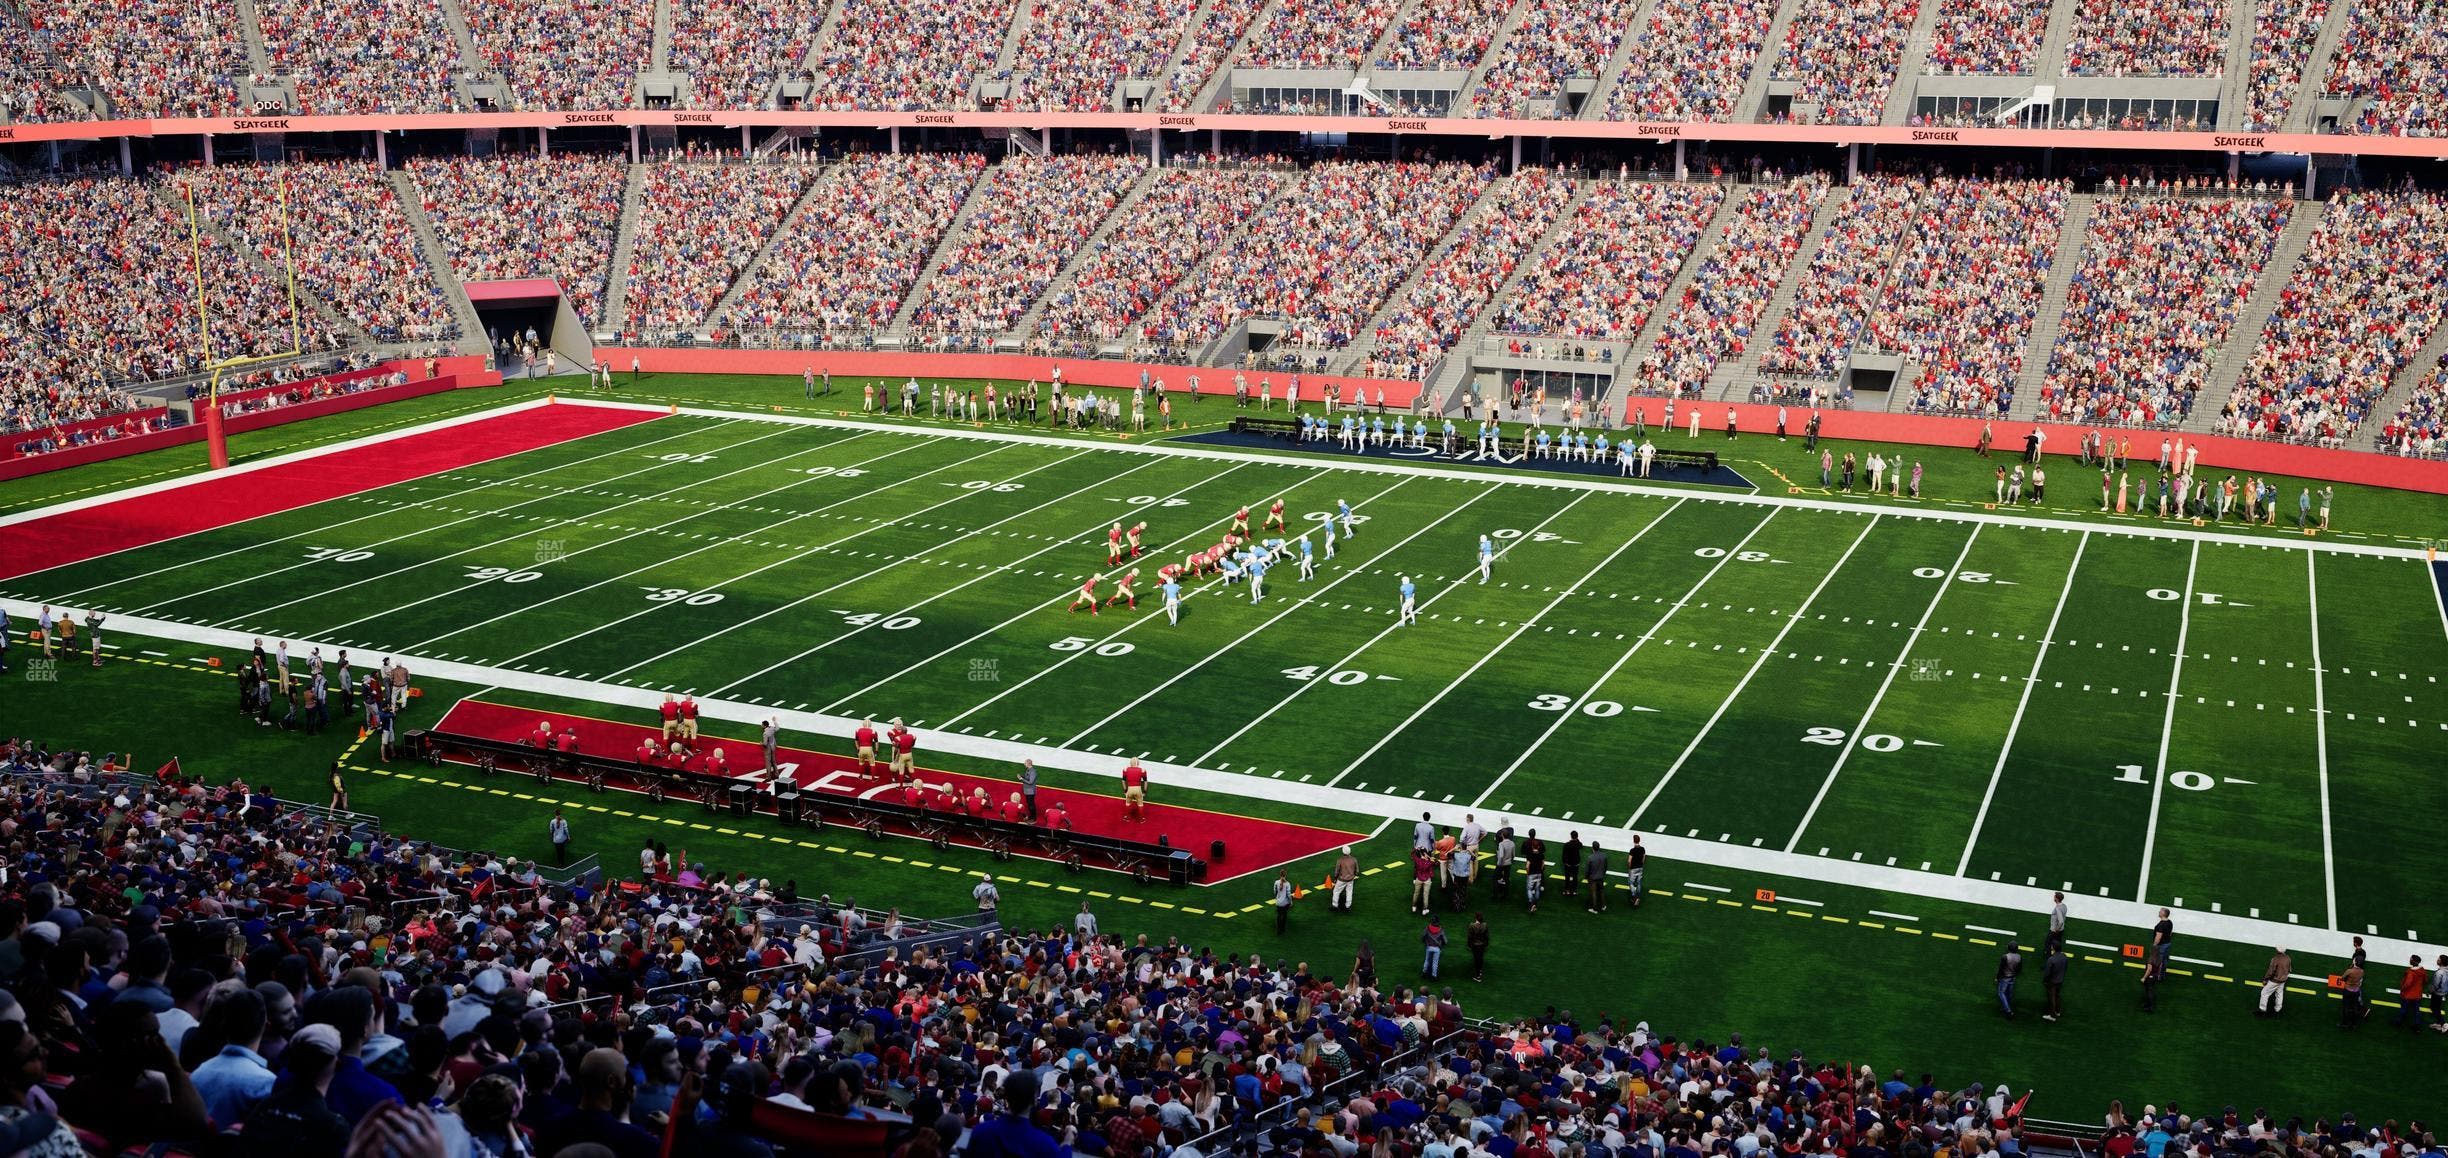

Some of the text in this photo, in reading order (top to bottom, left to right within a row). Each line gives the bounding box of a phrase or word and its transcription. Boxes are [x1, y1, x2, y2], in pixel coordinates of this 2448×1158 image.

[565, 113, 615, 123] SEATGEEK
[674, 113, 713, 122] SEATGEEK
[915, 115, 955, 124] SEATGEEK
[1159, 117, 1195, 126] SEATGEEK
[233, 120, 289, 129] SEATGEEK
[1388, 121, 1427, 131] SEATGEEK
[1638, 126, 1680, 136] SEATGEEK
[1912, 131, 1958, 141] SEATGEEK
[2214, 136, 2264, 148] SEATGEEK
[464, 567, 543, 583] 20
[645, 588, 725, 605] 30
[843, 613, 921, 630] 40
[1049, 636, 1135, 656] 50
[1280, 665, 1368, 685] 40
[1528, 694, 1624, 717] 30
[1800, 727, 1904, 752] 20
[2113, 765, 2215, 791] 10
[1761, 891, 1771, 900] 20
